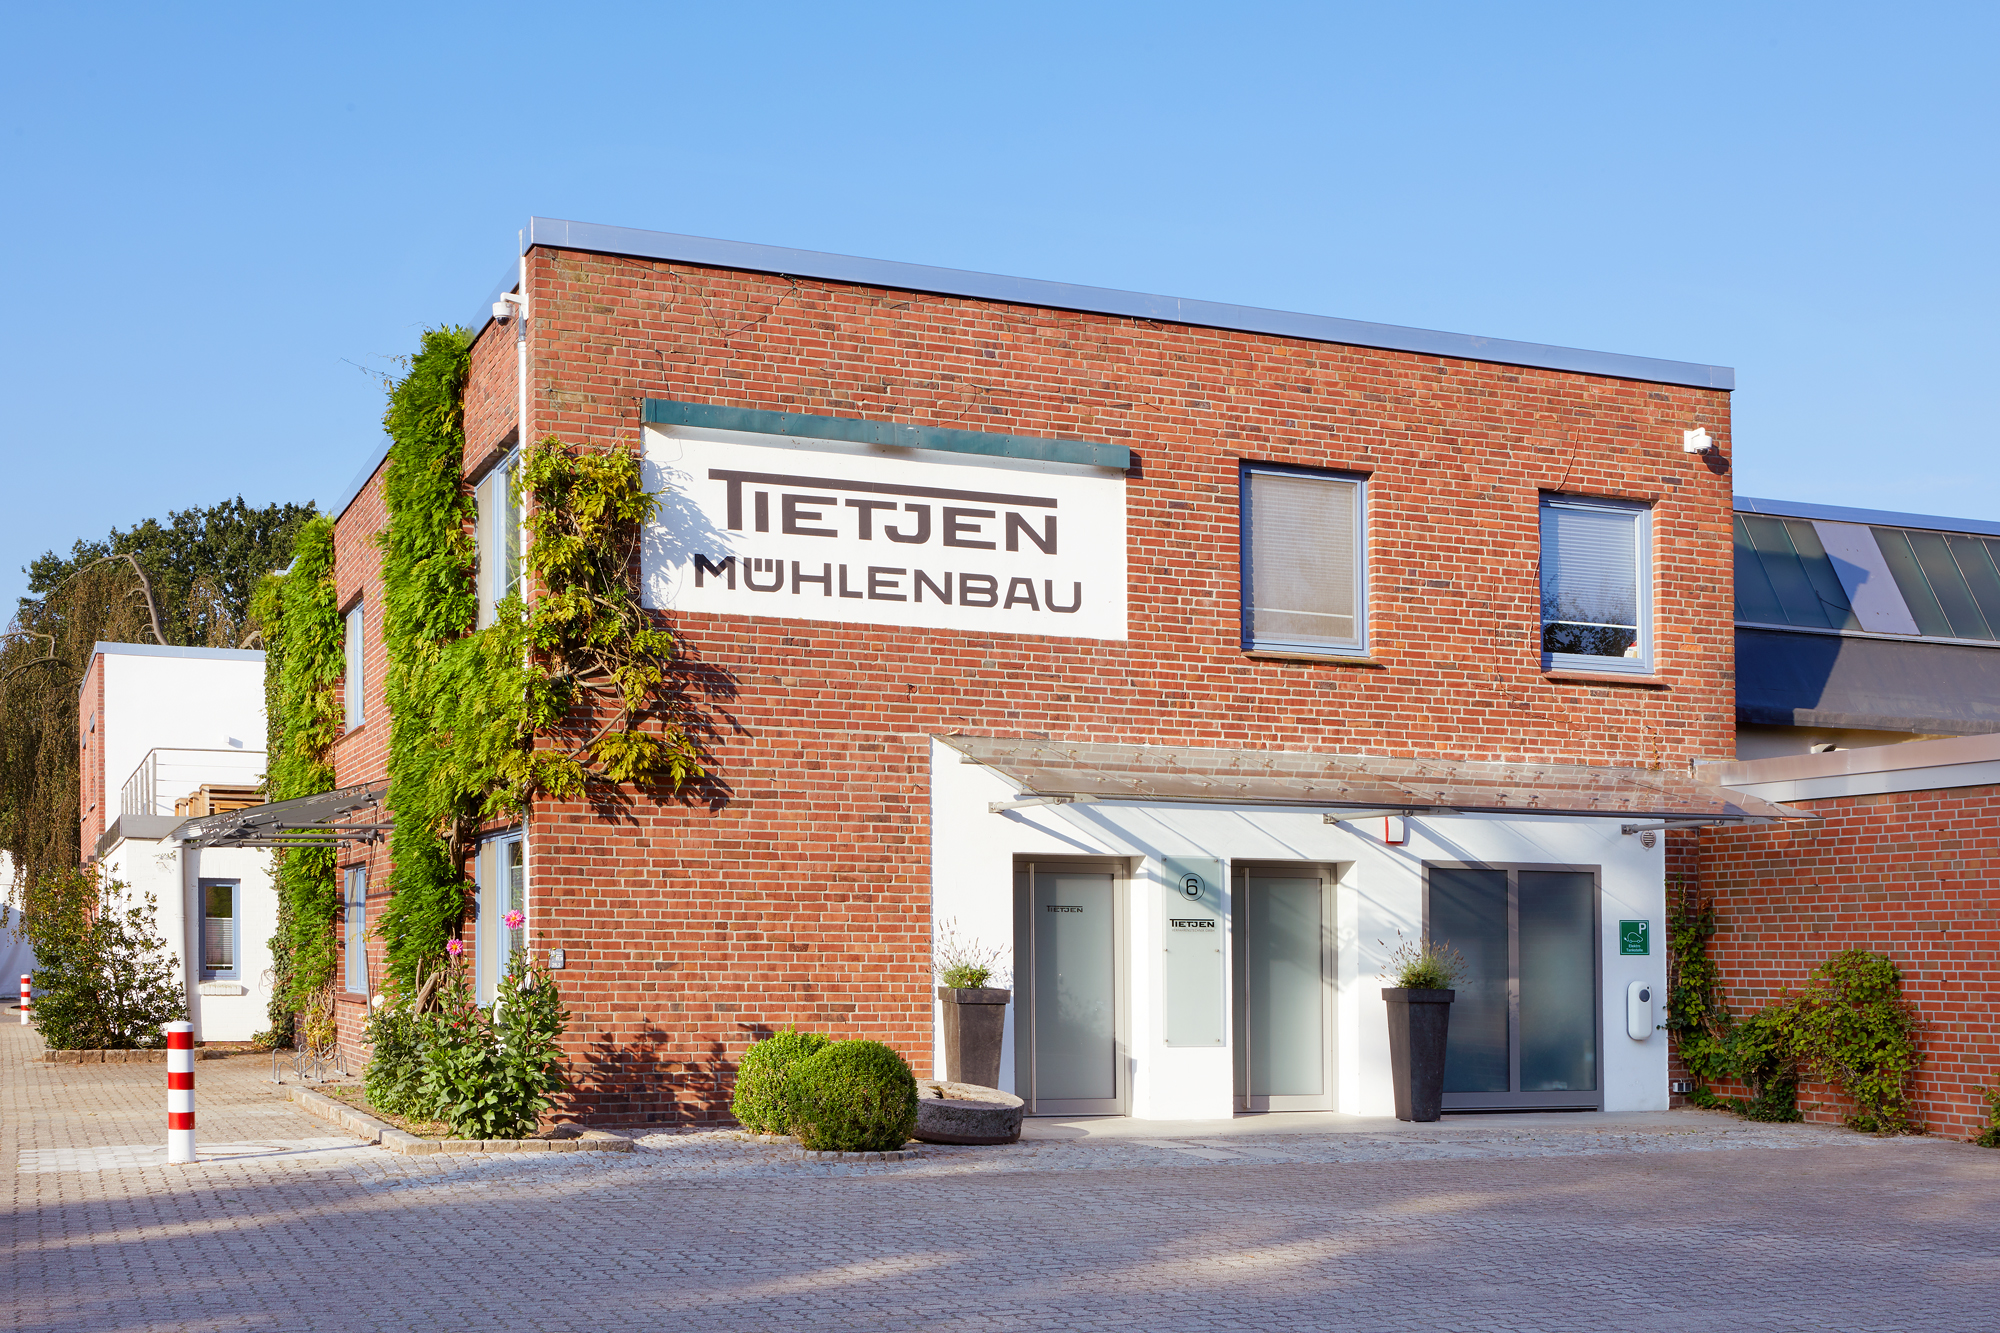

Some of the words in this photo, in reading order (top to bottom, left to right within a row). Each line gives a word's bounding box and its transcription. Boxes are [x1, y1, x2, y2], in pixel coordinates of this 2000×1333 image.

[708, 468, 1057, 555] TIETJEN
[695, 553, 1081, 613] MÜHLENBAU
[1186, 878, 1198, 896] 6
[1046, 905, 1083, 913] TIETJEN
[1169, 918, 1215, 928] TIETJEN
[1638, 922, 1647, 935] P
